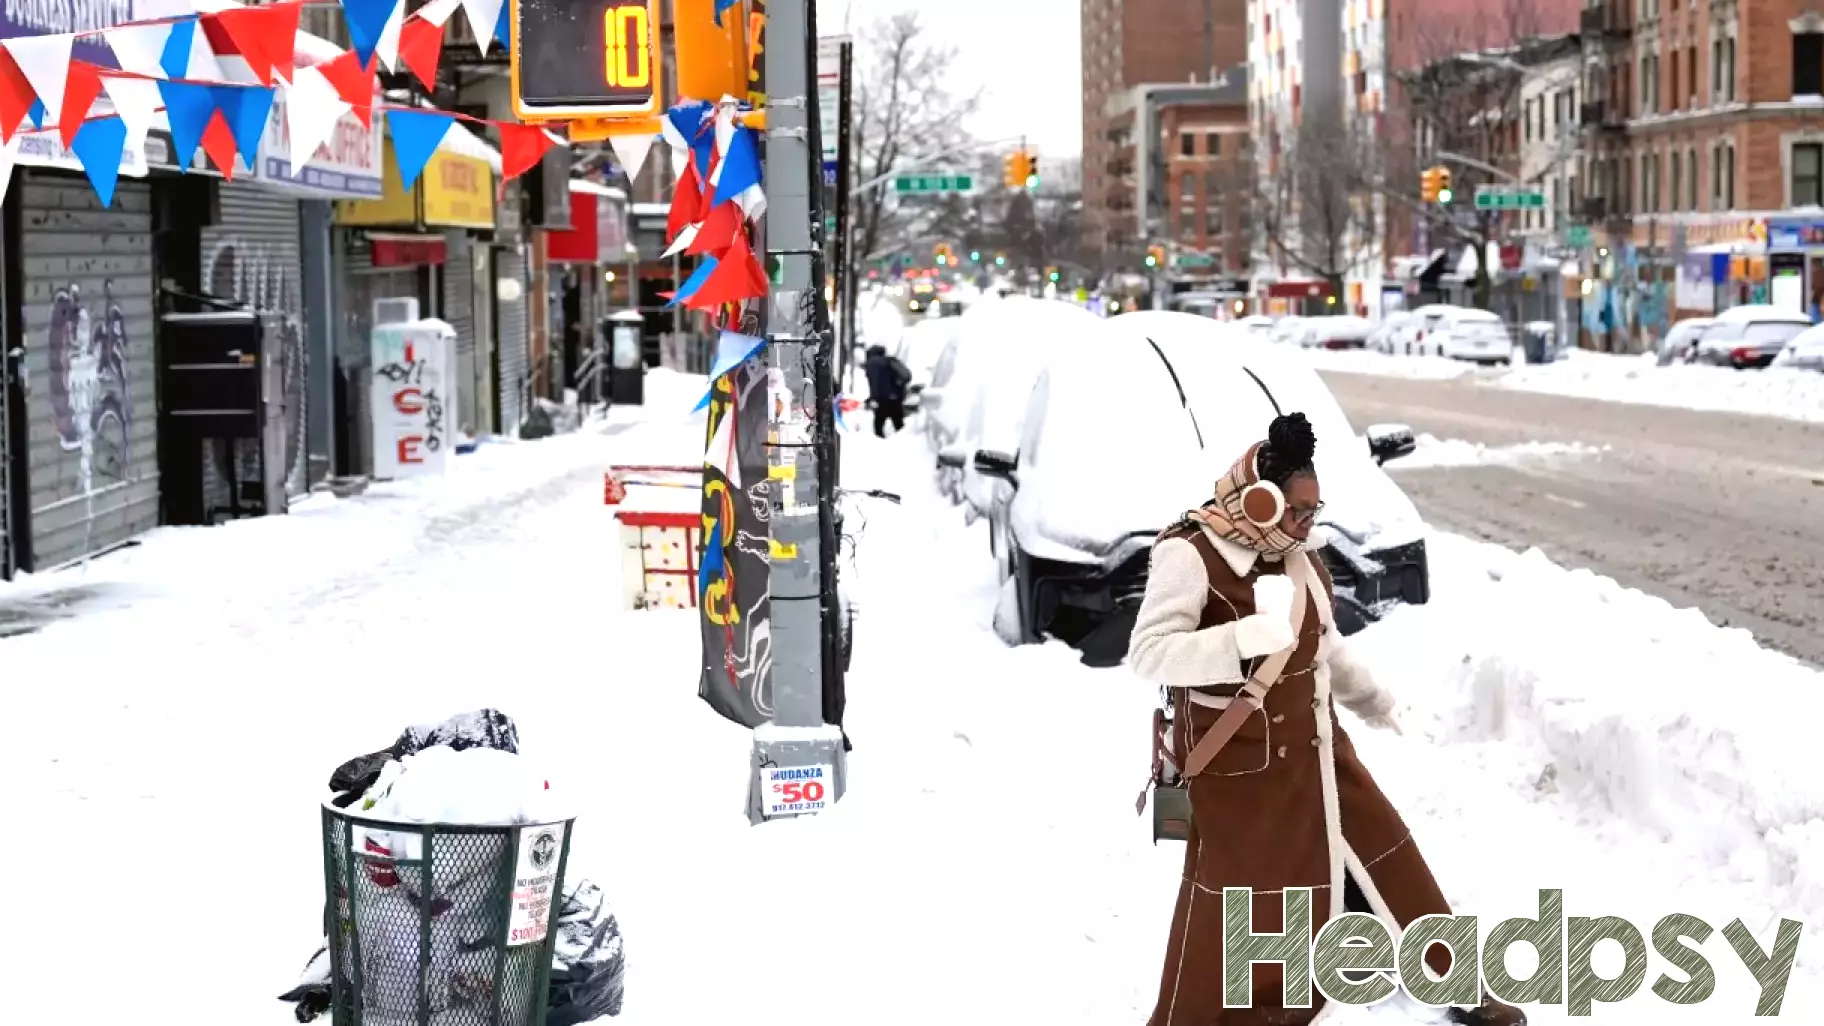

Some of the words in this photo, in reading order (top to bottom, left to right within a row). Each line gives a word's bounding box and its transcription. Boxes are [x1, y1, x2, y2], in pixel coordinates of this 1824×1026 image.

[604, 5, 650, 88] 10
[770, 768, 823, 781] MUDANZA
[772, 782, 824, 803] $50
